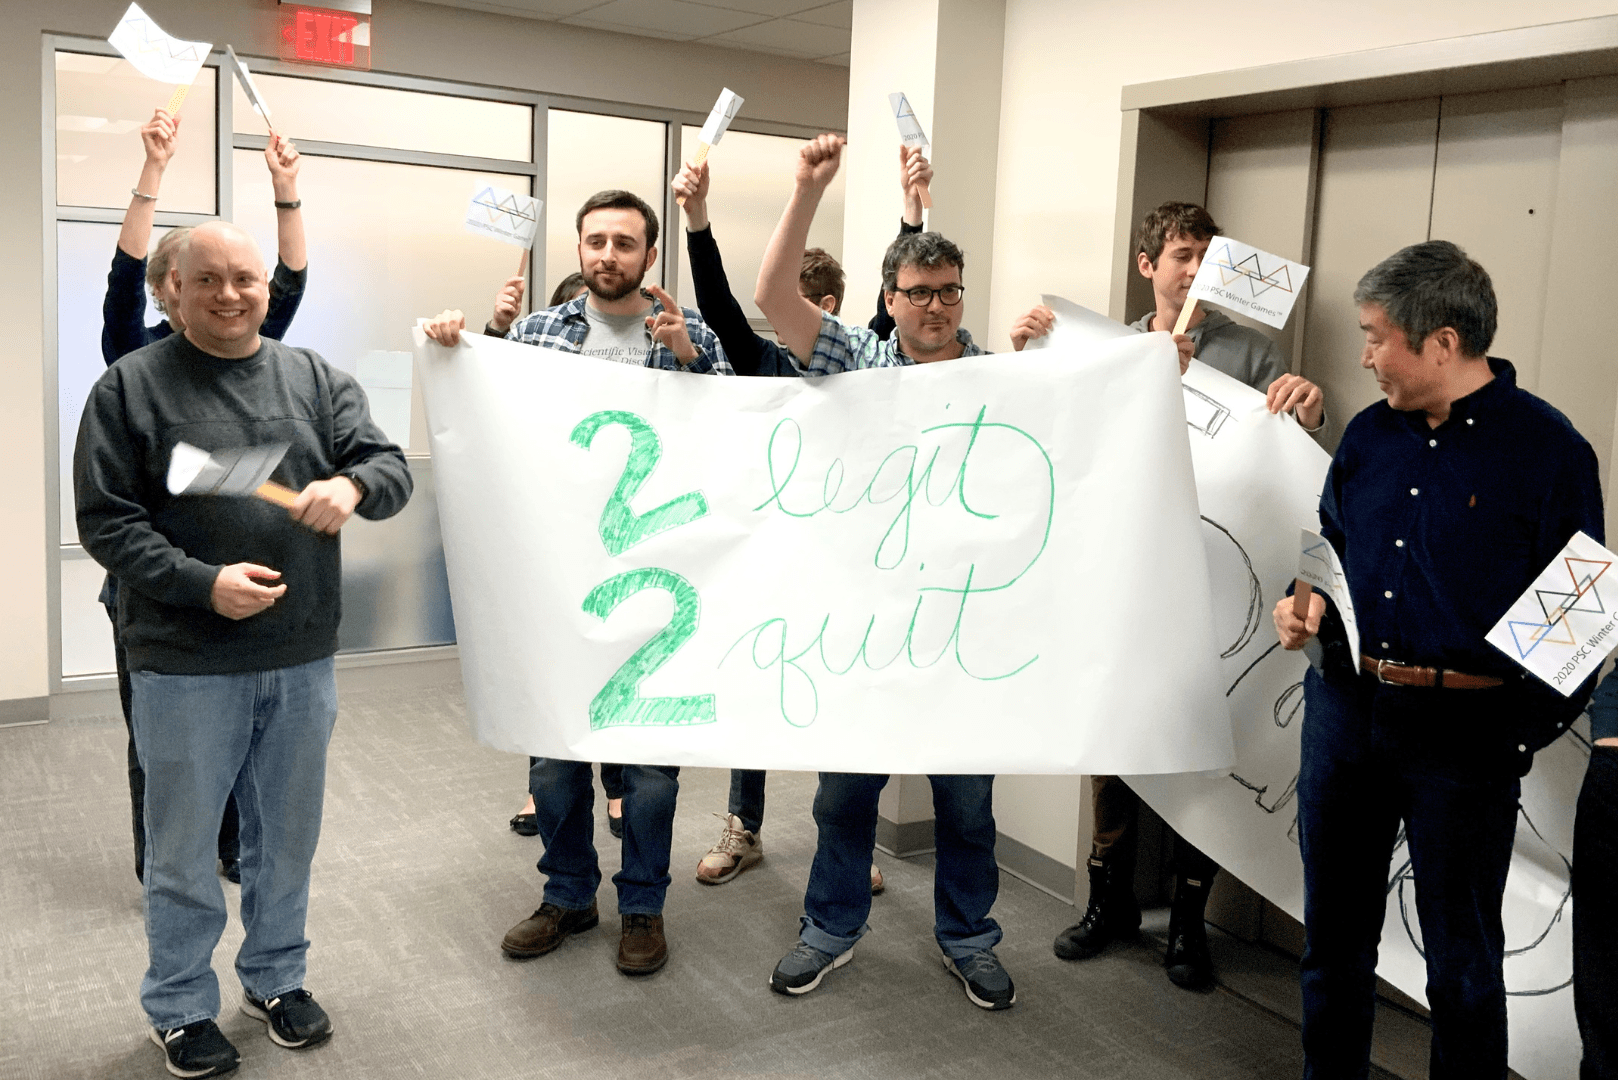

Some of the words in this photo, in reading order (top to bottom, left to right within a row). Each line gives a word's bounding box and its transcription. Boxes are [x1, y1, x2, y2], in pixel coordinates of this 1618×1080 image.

[297, 11, 356, 64] EXIT
[1210, 286, 1226, 297] PSC
[1225, 291, 1250, 307] Winter
[568, 410, 711, 558] 2
[753, 404, 1054, 570] legit
[580, 566, 718, 733] 2
[717, 563, 1040, 728] quit
[1552, 662, 1576, 685] 2020
[1571, 645, 1592, 664] PSC
[1586, 620, 1616, 648] Winter
